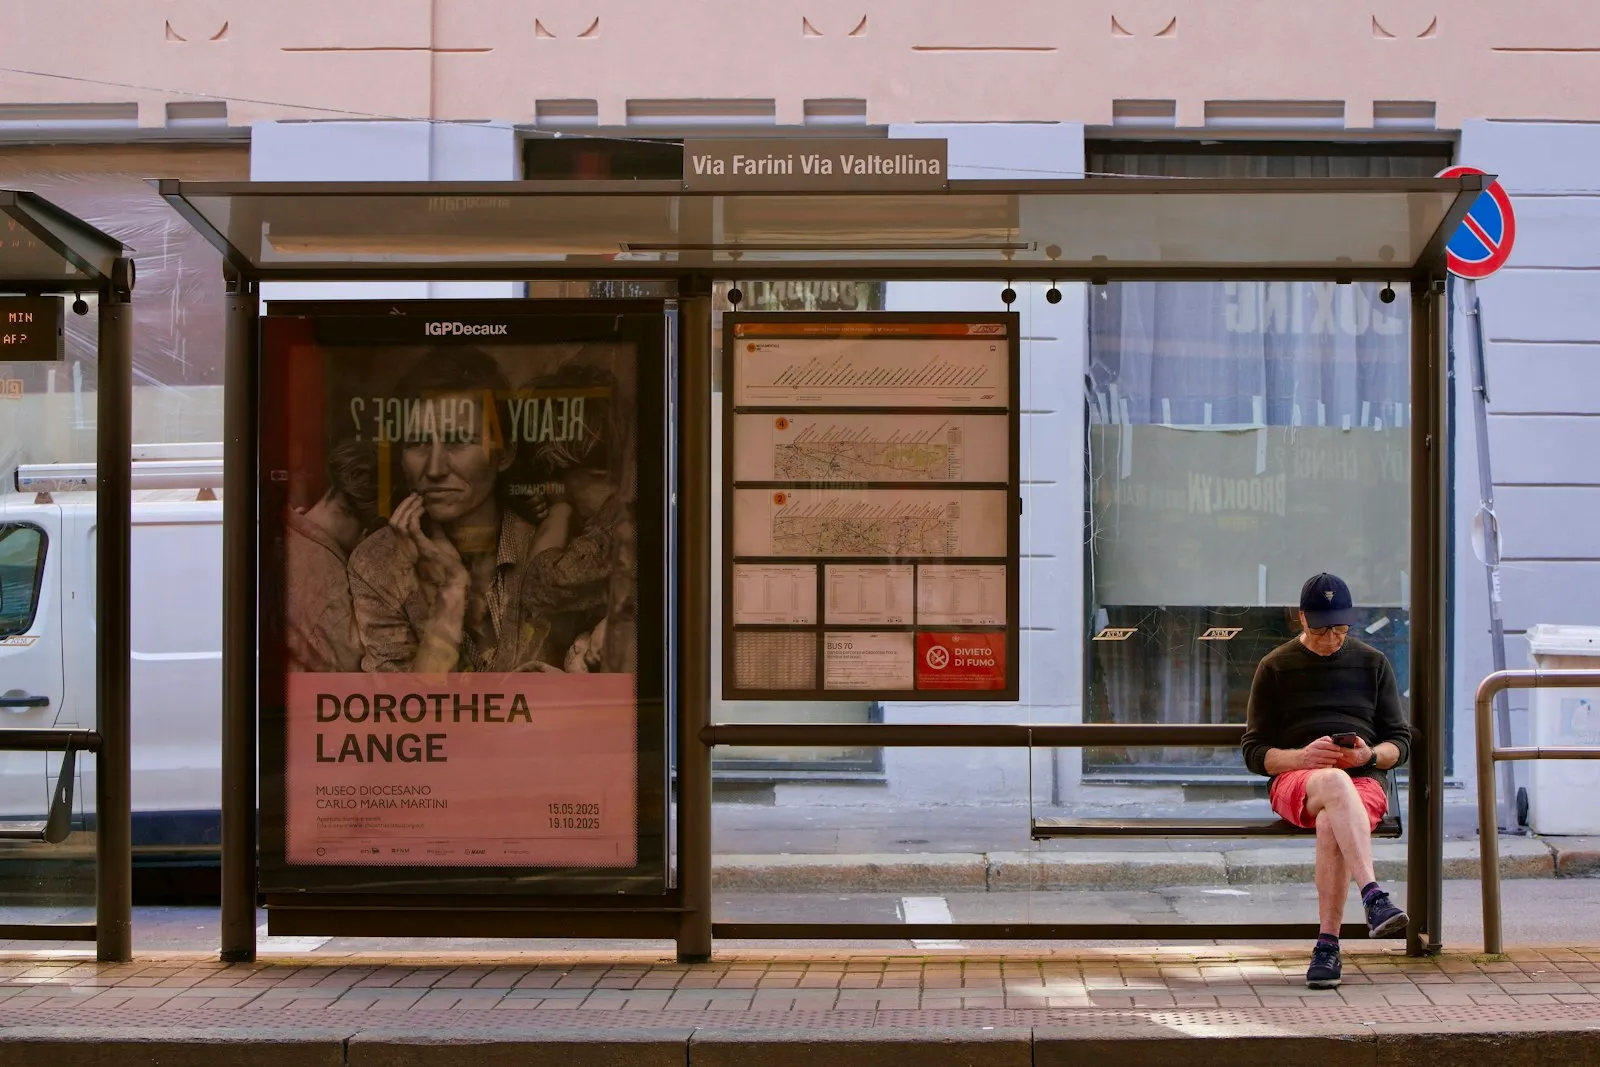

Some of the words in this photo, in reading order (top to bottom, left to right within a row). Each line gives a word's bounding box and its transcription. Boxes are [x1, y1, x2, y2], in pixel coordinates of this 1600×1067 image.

[693, 155, 725, 175] Via
[733, 155, 793, 175] Farini
[800, 155, 832, 175] Via
[840, 155, 940, 175] Valtellina
[9, 312, 33, 323] MIN
[425, 322, 507, 335] IGPDecaux
[955, 648, 992, 656] DIVIETO
[955, 659, 964, 667] DI
[967, 659, 995, 667] FUMO
[316, 693, 533, 723] DOROTHEA
[316, 733, 448, 763] LANGE
[316, 785, 356, 796] MUSEO
[359, 785, 431, 796] DIOCESANO
[316, 799, 357, 809] CARLO
[360, 799, 398, 809] MARIA
[400, 799, 448, 809] MARTINI
[548, 803, 599, 815] 15.05.2025
[549, 817, 600, 829] 19.10.2025
